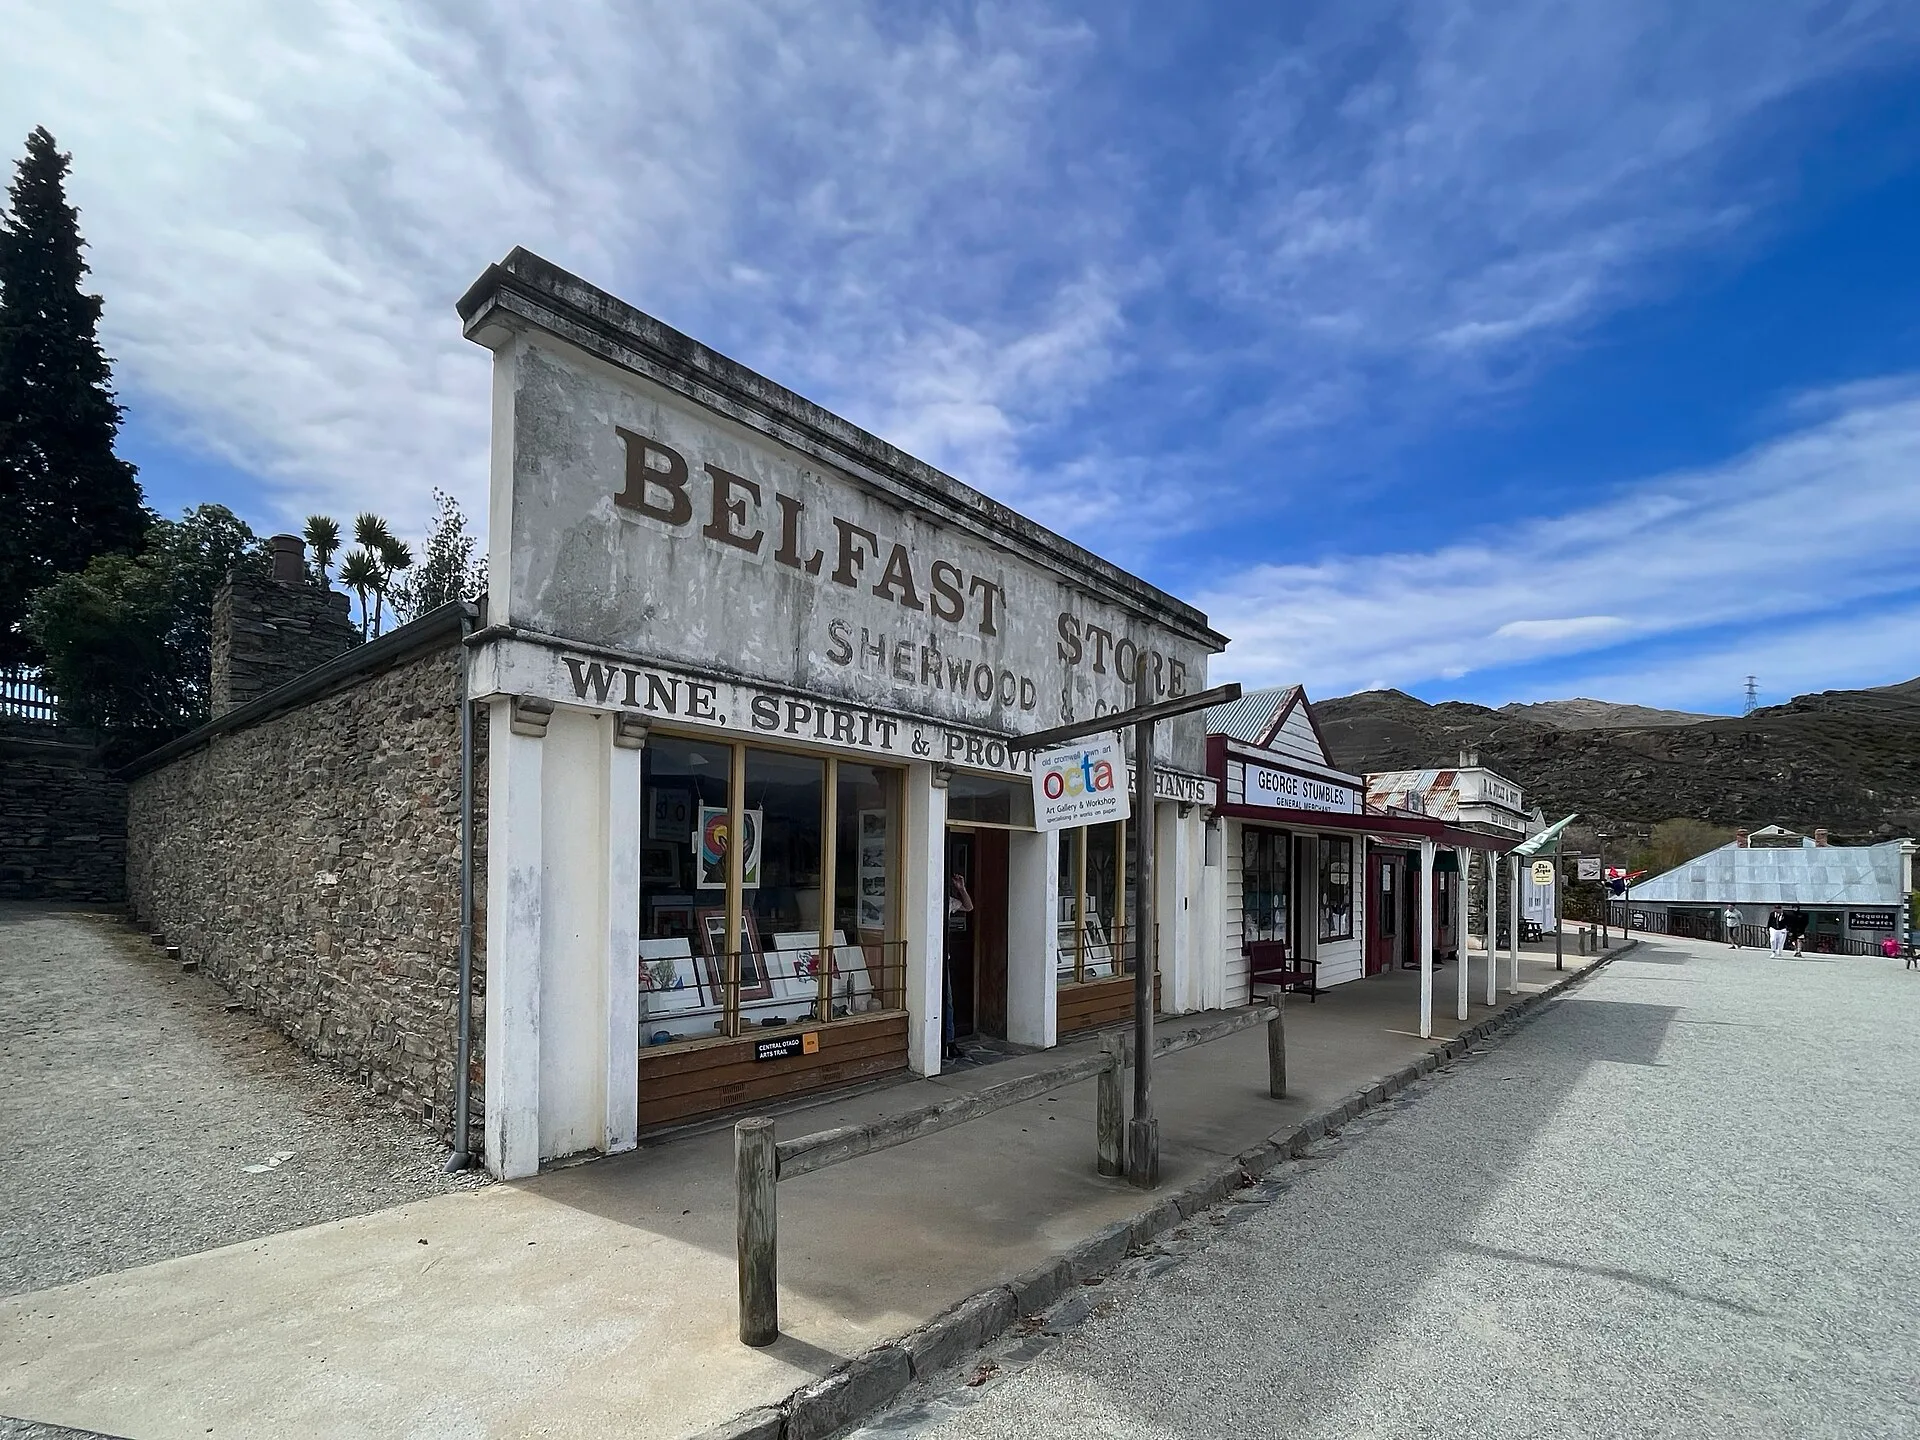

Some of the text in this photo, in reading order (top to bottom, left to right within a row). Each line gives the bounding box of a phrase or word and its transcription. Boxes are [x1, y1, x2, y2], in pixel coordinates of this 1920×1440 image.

[614, 426, 1006, 637] BELFAST
[826, 618, 1037, 711] SHERWOOD
[561, 656, 727, 726] WINE,
[750, 695, 898, 750] SPIRIT
[911, 729, 931, 757] &
[943, 730, 1033, 773] PROVI
[1041, 757, 1052, 767] old
[1053, 751, 1081, 764] cromwell
[1102, 745, 1112, 754] art
[1043, 754, 1115, 800] octa
[1258, 770, 1298, 796] GEORGE
[1046, 797, 1117, 815] Art Gallery & Workshop
[1276, 796, 1302, 810] GENERAL
[758, 1042, 782, 1051] CENTRAL
[782, 1039, 800, 1047] OTAGO
[759, 1051, 774, 1059] ARTS
